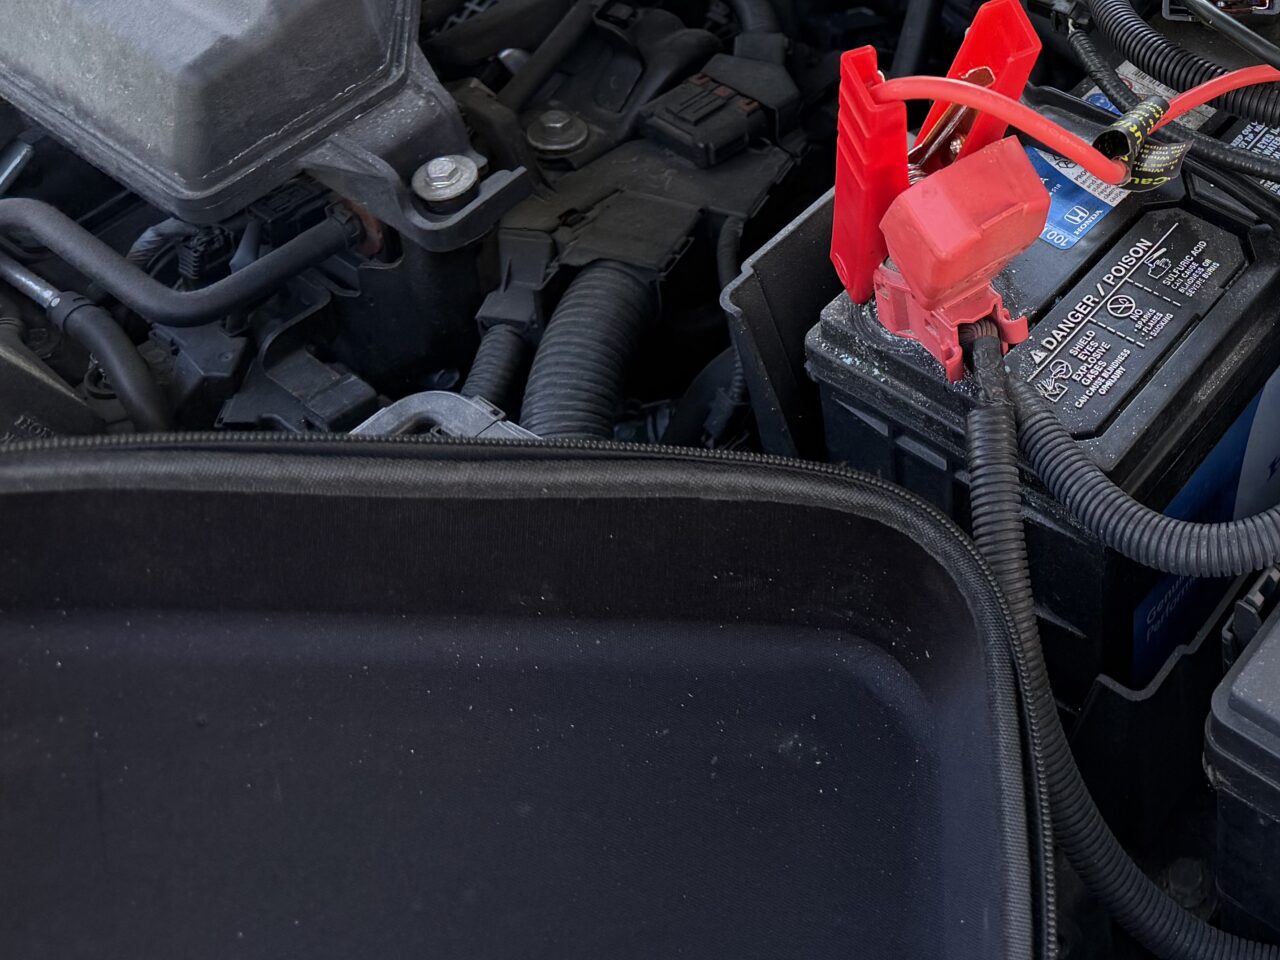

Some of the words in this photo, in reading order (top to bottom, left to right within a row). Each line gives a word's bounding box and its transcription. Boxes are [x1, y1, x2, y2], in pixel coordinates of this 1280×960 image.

[1073, 209, 1104, 236] HONDA
[1046, 231, 1071, 247] 100
[1162, 254, 1194, 286] SULFURIC
[1189, 240, 1208, 258] ACID
[1180, 261, 1199, 280] CAUSE
[1041, 293, 1100, 352] DANGER
[1102, 237, 1154, 286] POISON
[1130, 308, 1144, 321] NO
[1135, 308, 1156, 330] SPARKS
[1068, 329, 1096, 357] SHIELD
[1078, 339, 1100, 361] EYES
[1071, 340, 1111, 382] EXPLOSIVE
[1080, 359, 1108, 387] GASES
[1074, 393, 1090, 410] CAN
[1087, 375, 1108, 397] CAUSE
[1103, 348, 1131, 379] BLINDNESS
